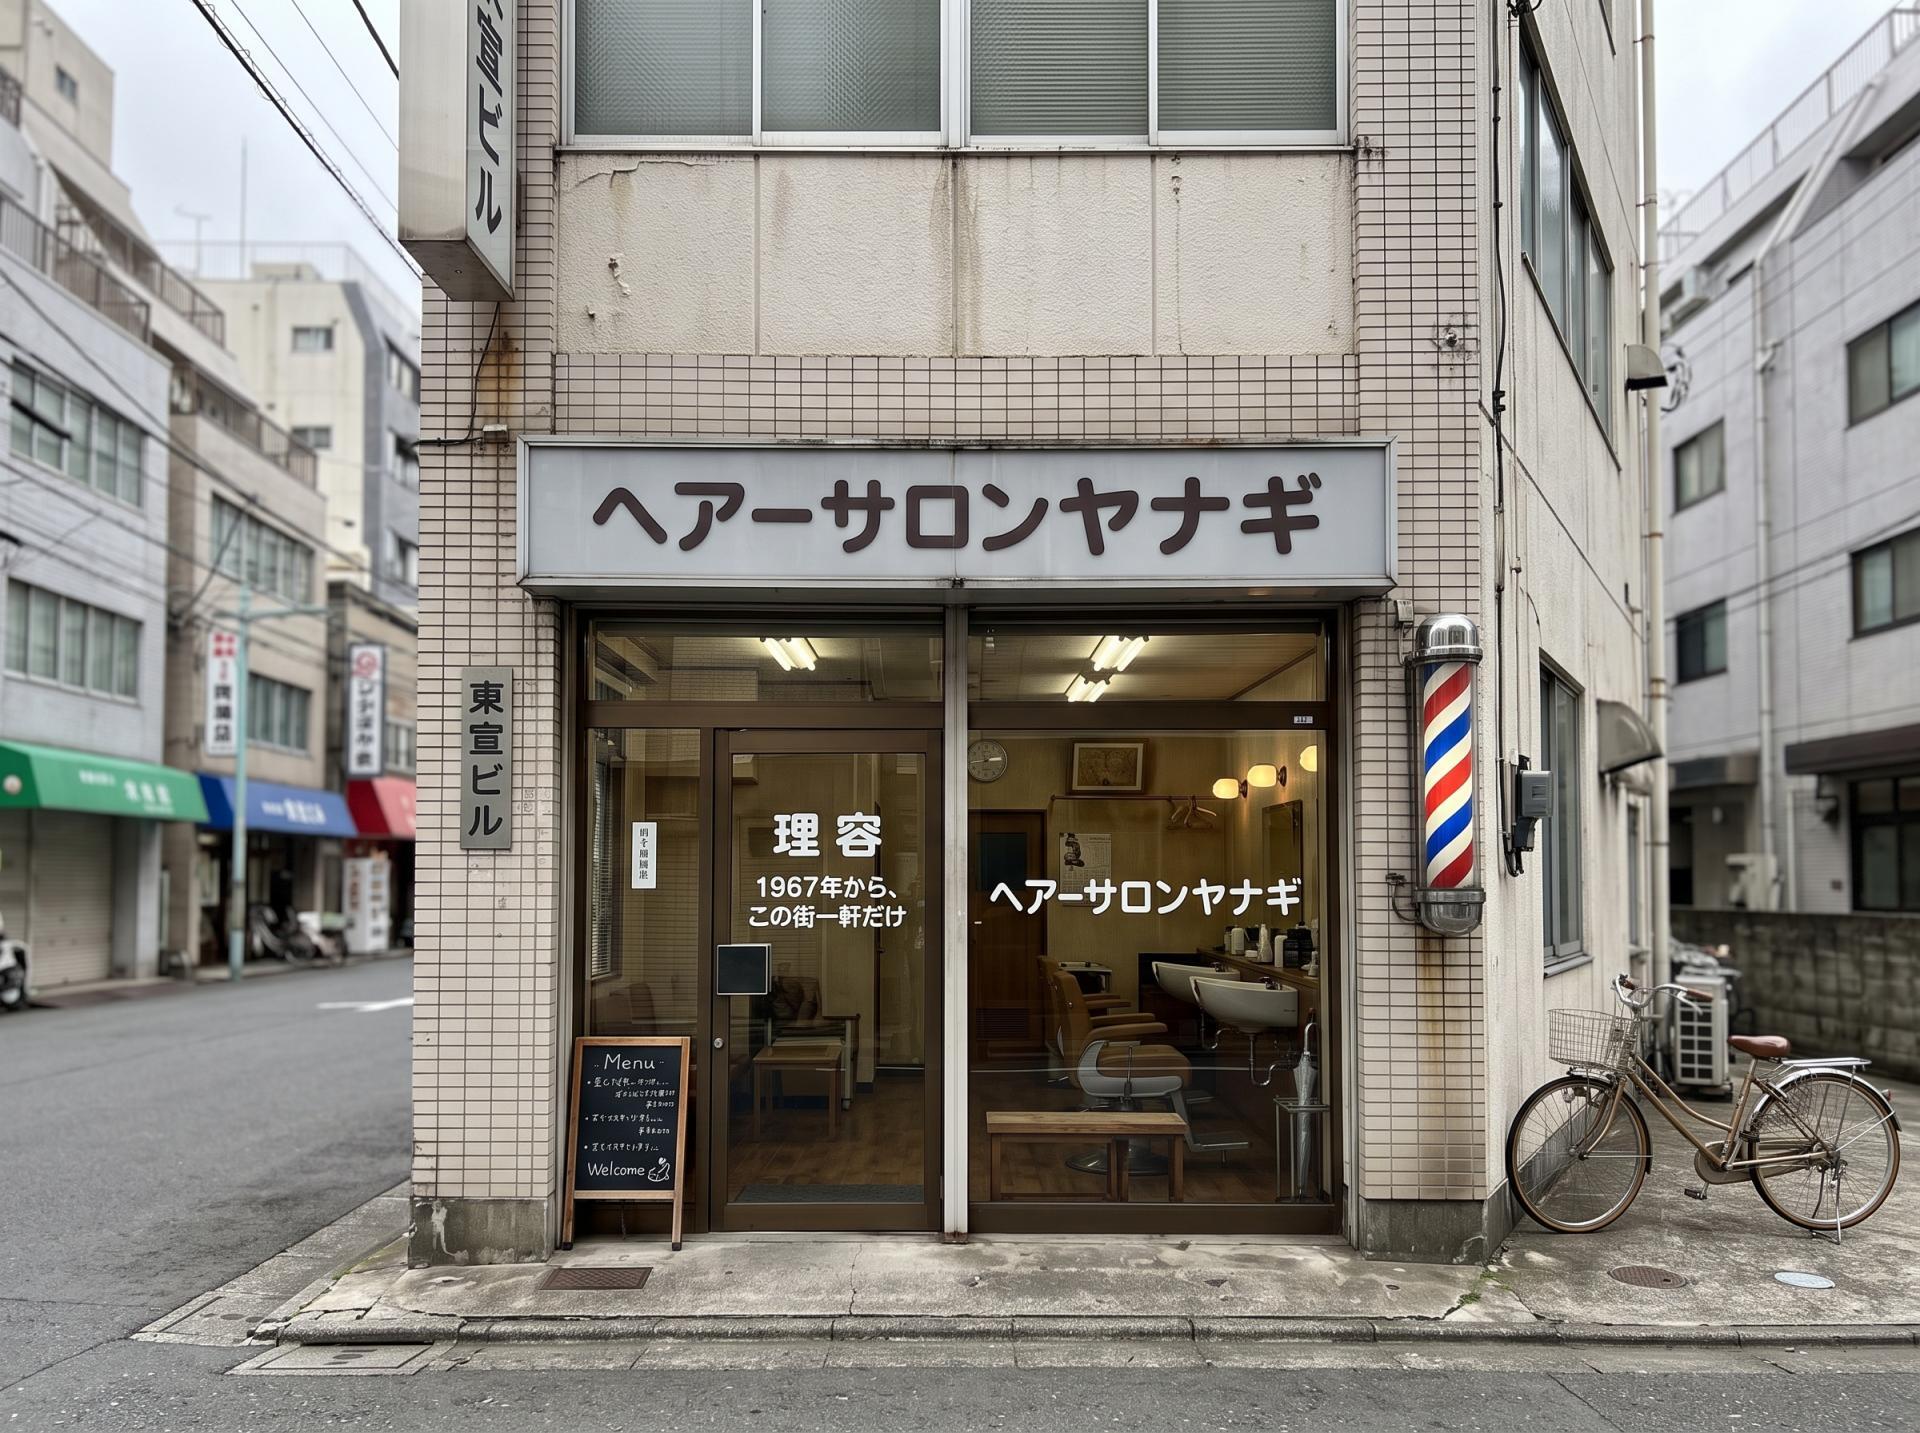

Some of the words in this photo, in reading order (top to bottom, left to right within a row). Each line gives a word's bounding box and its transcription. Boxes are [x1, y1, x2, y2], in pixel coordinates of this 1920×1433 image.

[475, 0, 503, 235] 宣ビル
[593, 473, 1322, 556] ヘアーサロンヤナギ
[468, 680, 504, 837] 東宣ビル
[773, 812, 882, 857] 理容
[756, 875, 897, 899] 1967年から、
[990, 877, 1302, 916] ヘアーサロンヤナギ
[749, 904, 907, 928] この街一軒だけ
[603, 1053, 655, 1070] Menu
[587, 1161, 646, 1177] Welcome
